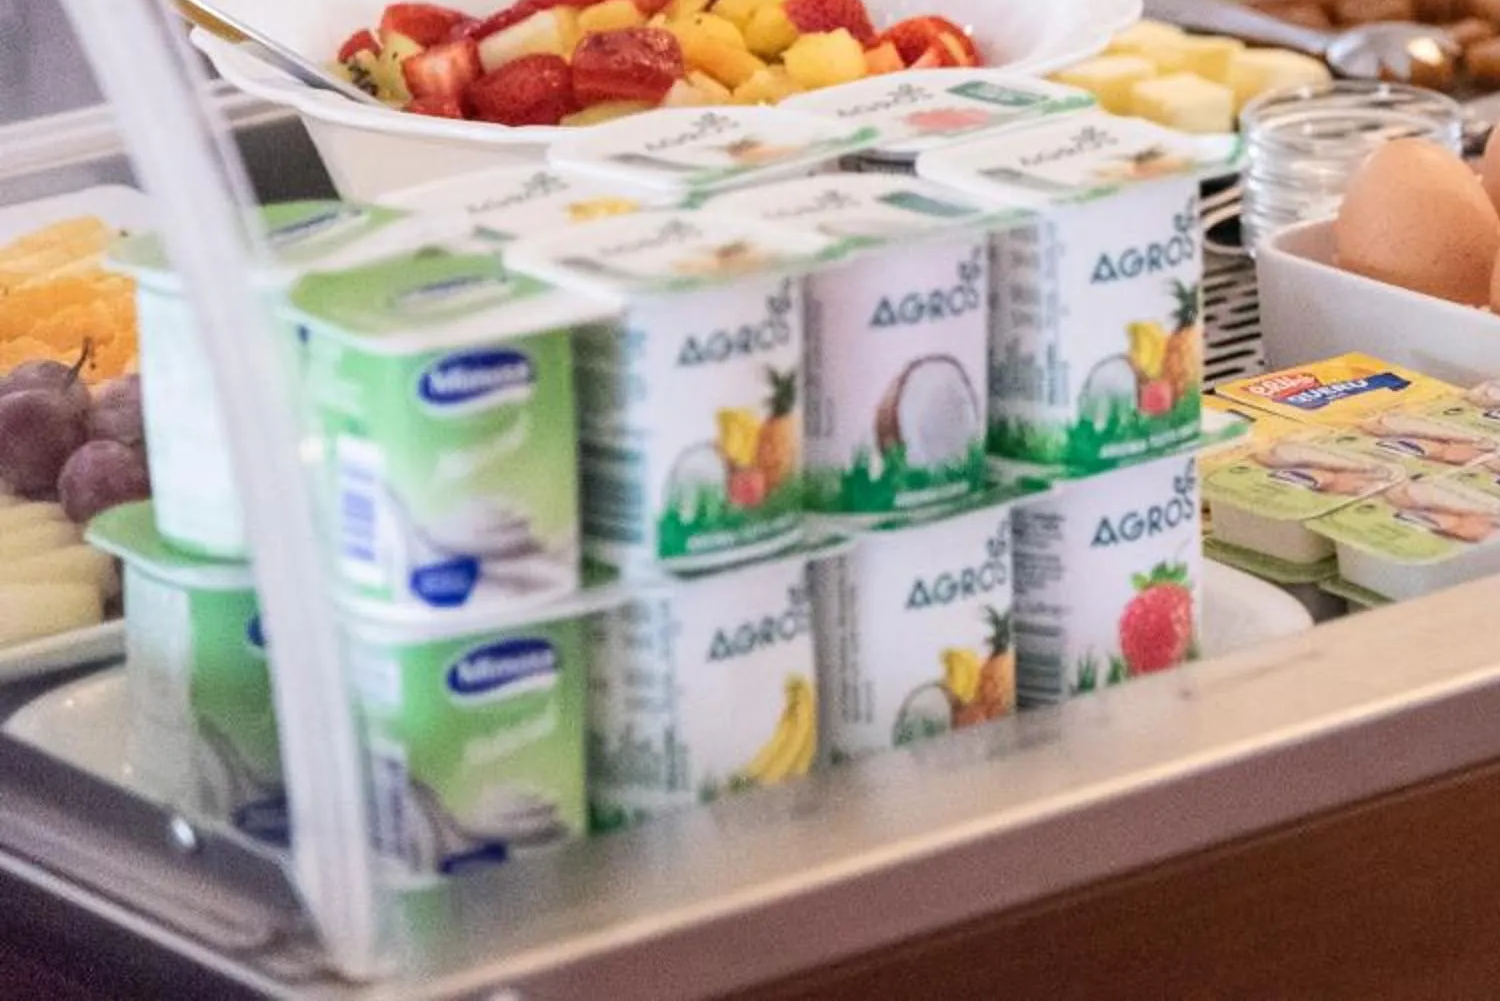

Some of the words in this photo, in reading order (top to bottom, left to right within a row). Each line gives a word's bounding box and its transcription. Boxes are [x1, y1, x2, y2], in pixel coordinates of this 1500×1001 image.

[1090, 235, 1194, 285] AGROS
[868, 284, 979, 330] AGROS
[676, 319, 790, 367] AGROS
[1090, 497, 1195, 549] AGROS
[903, 560, 1007, 611] AGROS
